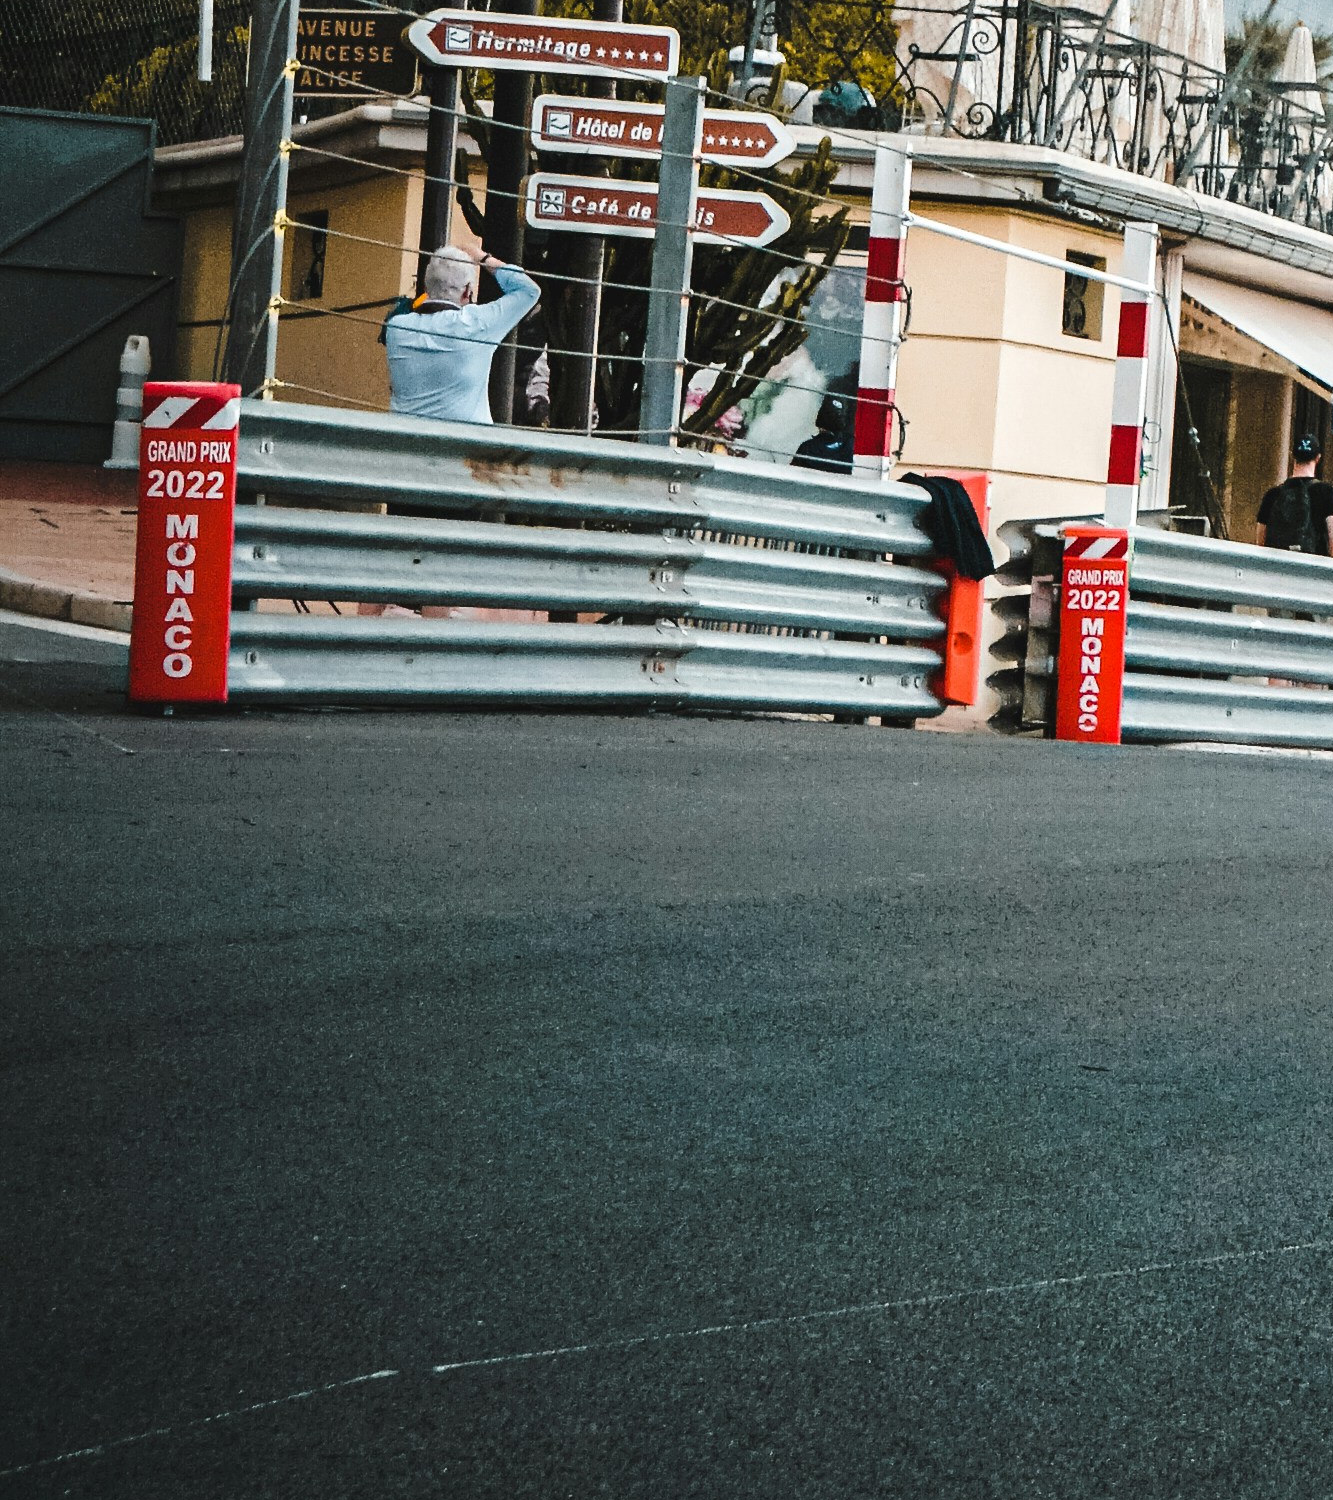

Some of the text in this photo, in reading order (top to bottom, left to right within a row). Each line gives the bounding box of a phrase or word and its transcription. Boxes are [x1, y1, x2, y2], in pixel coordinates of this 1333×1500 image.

[301, 44, 394, 63] INCESSE
[477, 30, 590, 60] Hermitage
[300, 69, 363, 87] ALICE
[576, 116, 625, 139] Hôtel
[630, 122, 652, 141] de
[571, 195, 652, 220] Café de
[148, 440, 231, 463] GRAND PRIX
[147, 469, 224, 499] 2022
[1067, 568, 1124, 586] GRAND PRIX
[163, 514, 199, 678] MONACO
[1067, 589, 1120, 611] 2022
[1078, 617, 1104, 732] MONACO
